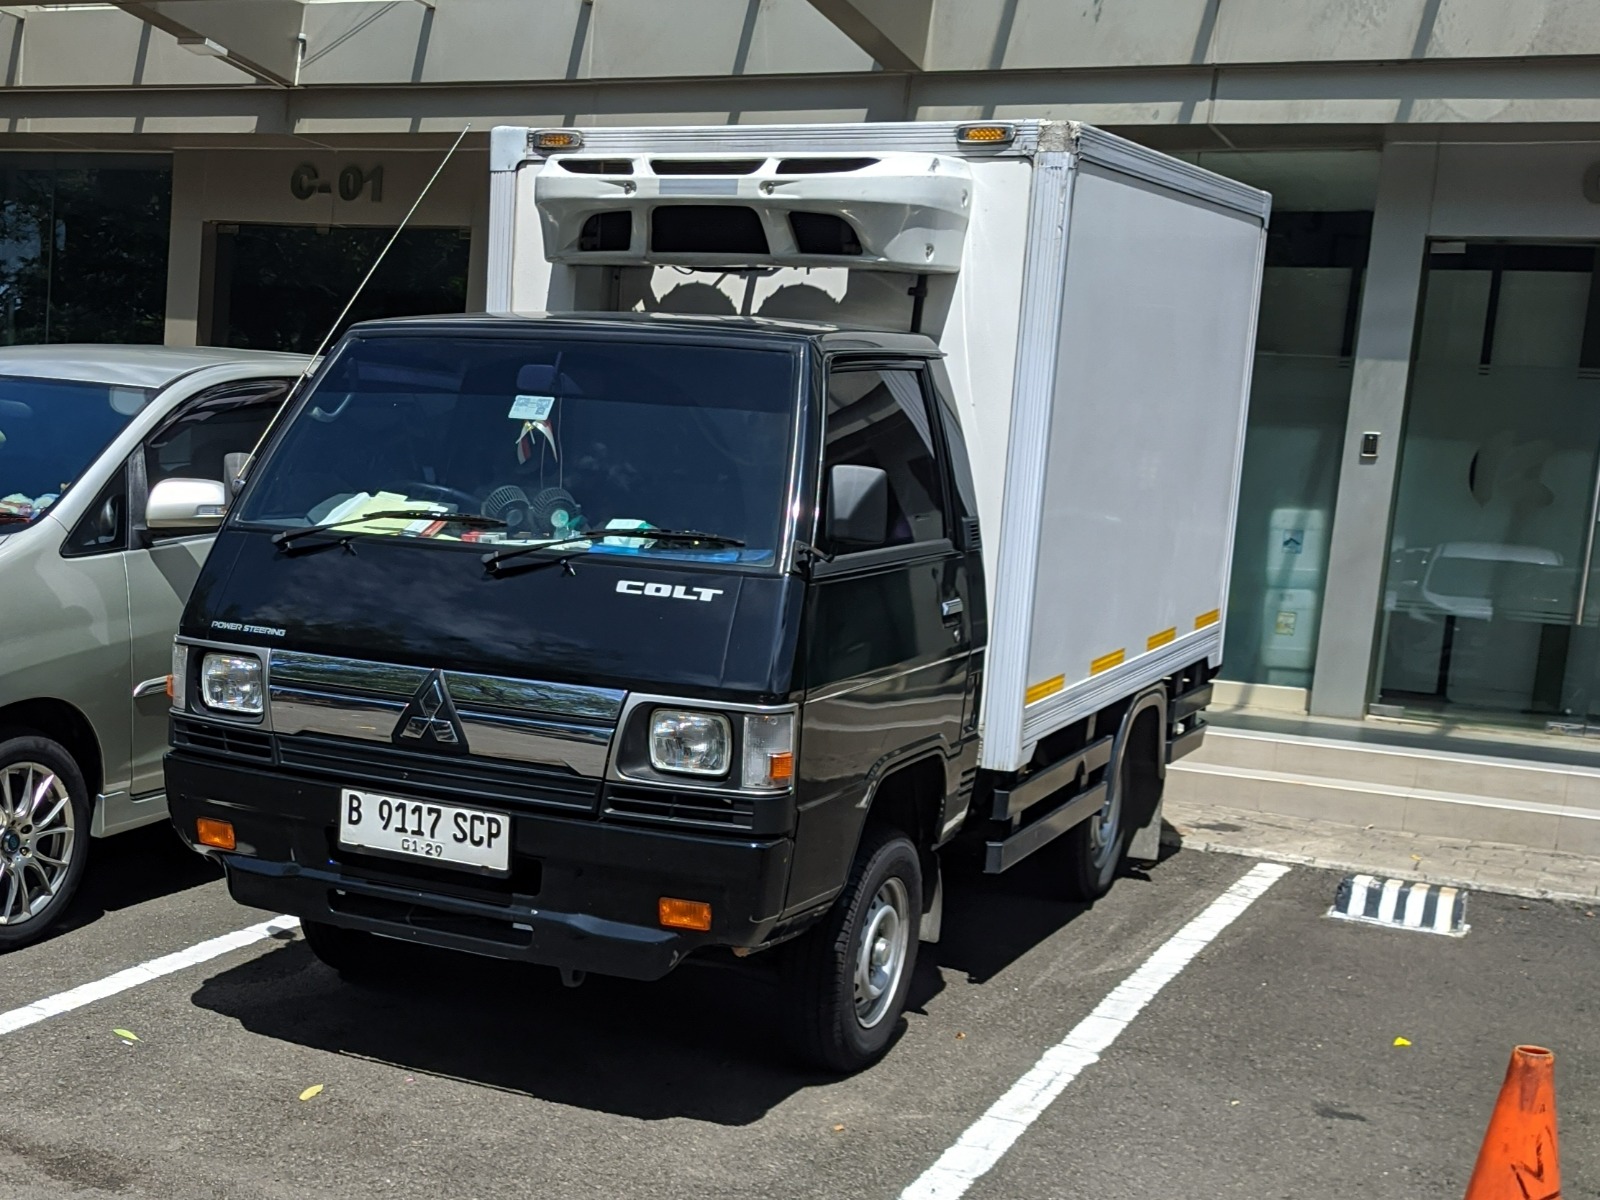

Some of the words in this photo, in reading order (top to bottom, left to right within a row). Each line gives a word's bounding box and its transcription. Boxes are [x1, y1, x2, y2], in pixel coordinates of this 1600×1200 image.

[616, 580, 724, 602] COLT
[211, 620, 242, 631] POWER
[243, 624, 286, 637] STEERING
[348, 794, 363, 826] B
[378, 799, 442, 839] 9117
[452, 811, 502, 848] SCP
